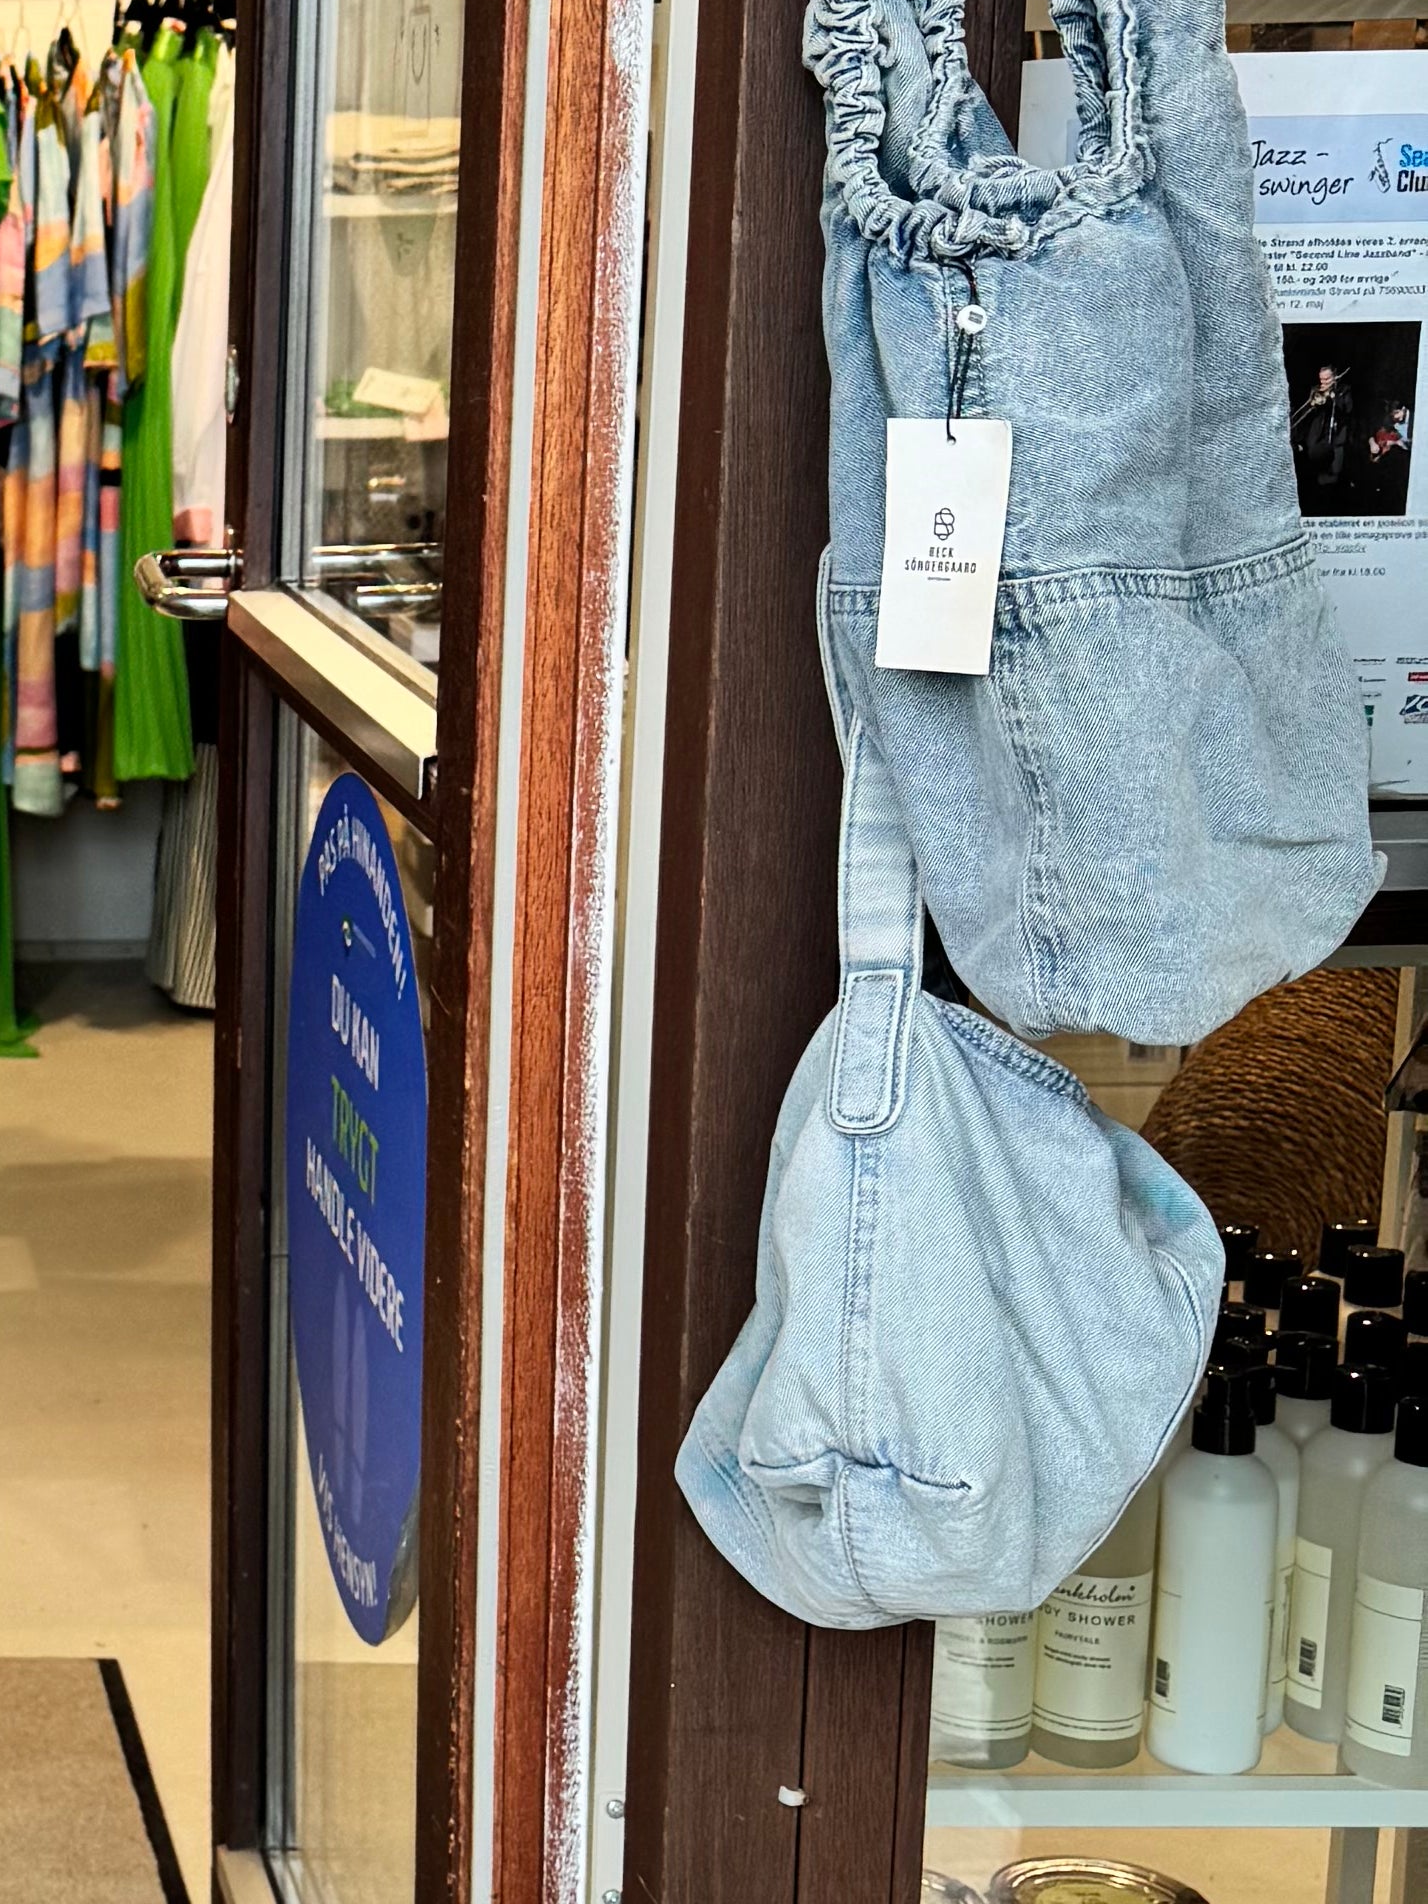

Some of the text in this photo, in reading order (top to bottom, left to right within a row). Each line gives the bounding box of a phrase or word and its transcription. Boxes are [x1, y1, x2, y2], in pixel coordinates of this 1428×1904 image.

[1259, 175, 1354, 205] swinger
[331, 973, 380, 1091] DU KAN
[331, 1074, 380, 1205] TRYGT
[306, 1137, 404, 1352] HANDLE VIDERE
[1067, 1612, 1136, 1627] SHOWER
